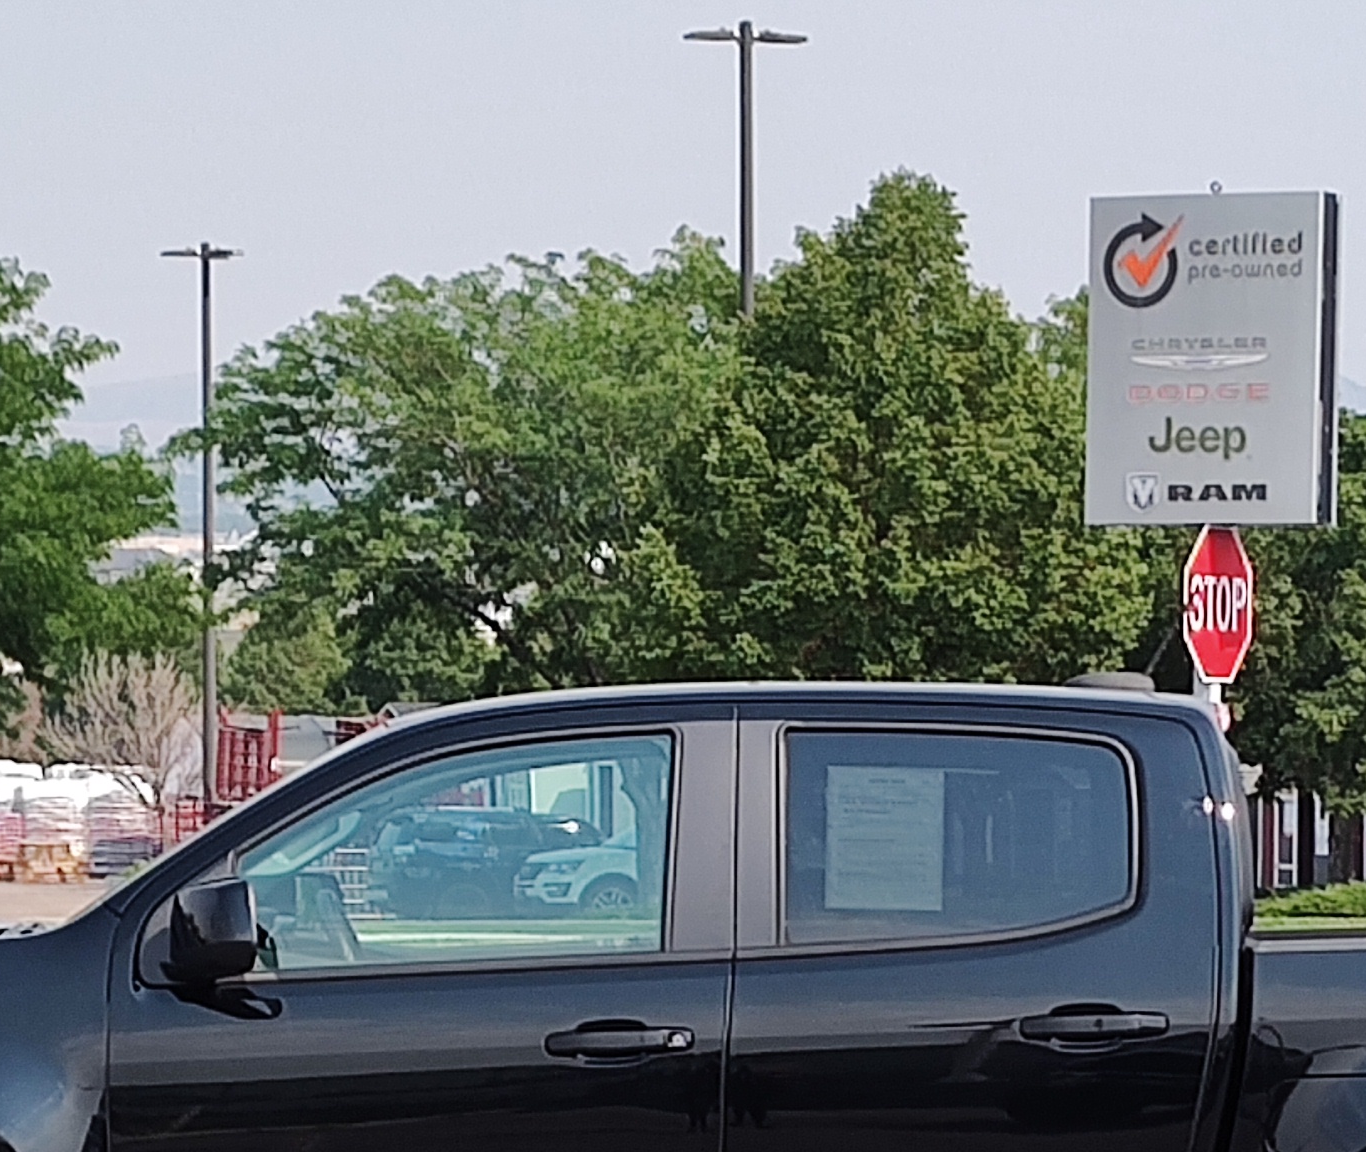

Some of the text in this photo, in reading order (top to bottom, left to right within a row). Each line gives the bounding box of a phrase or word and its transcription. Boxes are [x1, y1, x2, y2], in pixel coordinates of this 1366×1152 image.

[1188, 231, 1303, 257] certified
[1187, 259, 1302, 285] pre-owned
[1131, 336, 1267, 350] CHRYSLER
[1129, 382, 1270, 401] DODGE
[1148, 415, 1247, 460] Jeep
[1167, 484, 1267, 502] RAM
[1188, 573, 1247, 633] STOP
